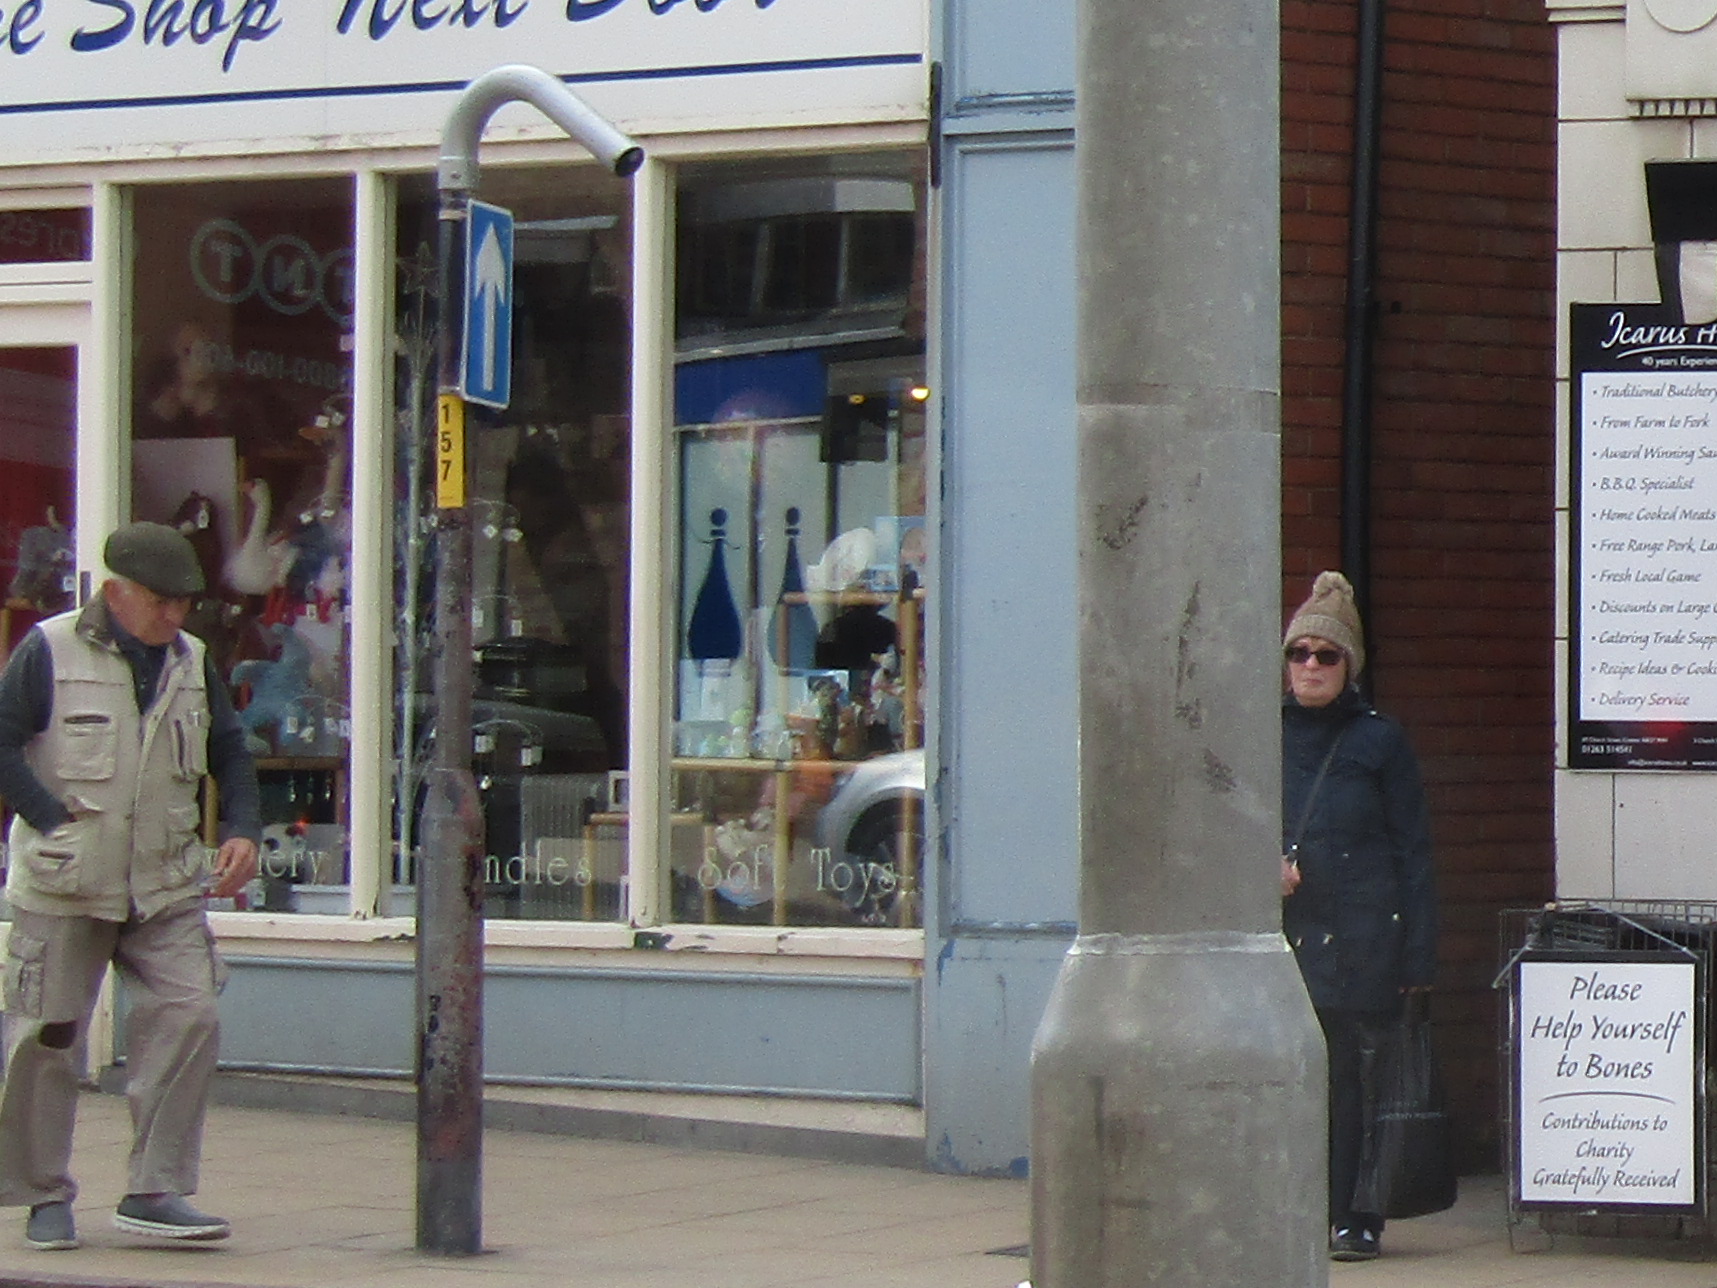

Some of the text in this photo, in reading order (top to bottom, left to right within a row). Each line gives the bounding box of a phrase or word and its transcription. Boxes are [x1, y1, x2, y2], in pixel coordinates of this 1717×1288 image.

[1601, 311, 1686, 349] Icarus
[1601, 384, 1665, 399] Traditional
[1600, 414, 1710, 430] From Farm to Fork
[1600, 445, 1641, 460] Award
[1644, 446, 1695, 463] Winning
[1641, 476, 1695, 493] Specialist
[1600, 507, 1717, 522] Home Cooked Meats
[1600, 539, 1625, 553] Free
[1628, 539, 1665, 556] Range
[1600, 569, 1701, 584] Fresh Local Game
[1599, 600, 1656, 614] Discounts
[1660, 604, 1674, 614] on
[1677, 601, 1710, 617] Large
[1599, 631, 1650, 648] Catering
[1653, 631, 1685, 645] Trade
[1599, 662, 1635, 679] Recipe
[1638, 662, 1668, 676] Ideas
[1599, 692, 1690, 709] Delivery Service
[484, 839, 592, 887] ndles
[698, 844, 785, 892] Sof
[1570, 972, 1642, 1001] Please
[1531, 1009, 1686, 1054] Help Yourself
[1557, 1053, 1653, 1080] to Bones
[1541, 1111, 1668, 1132] Contributions to
[1576, 1141, 1635, 1167] Charity
[1533, 1168, 1681, 1195] Gratefully Received
